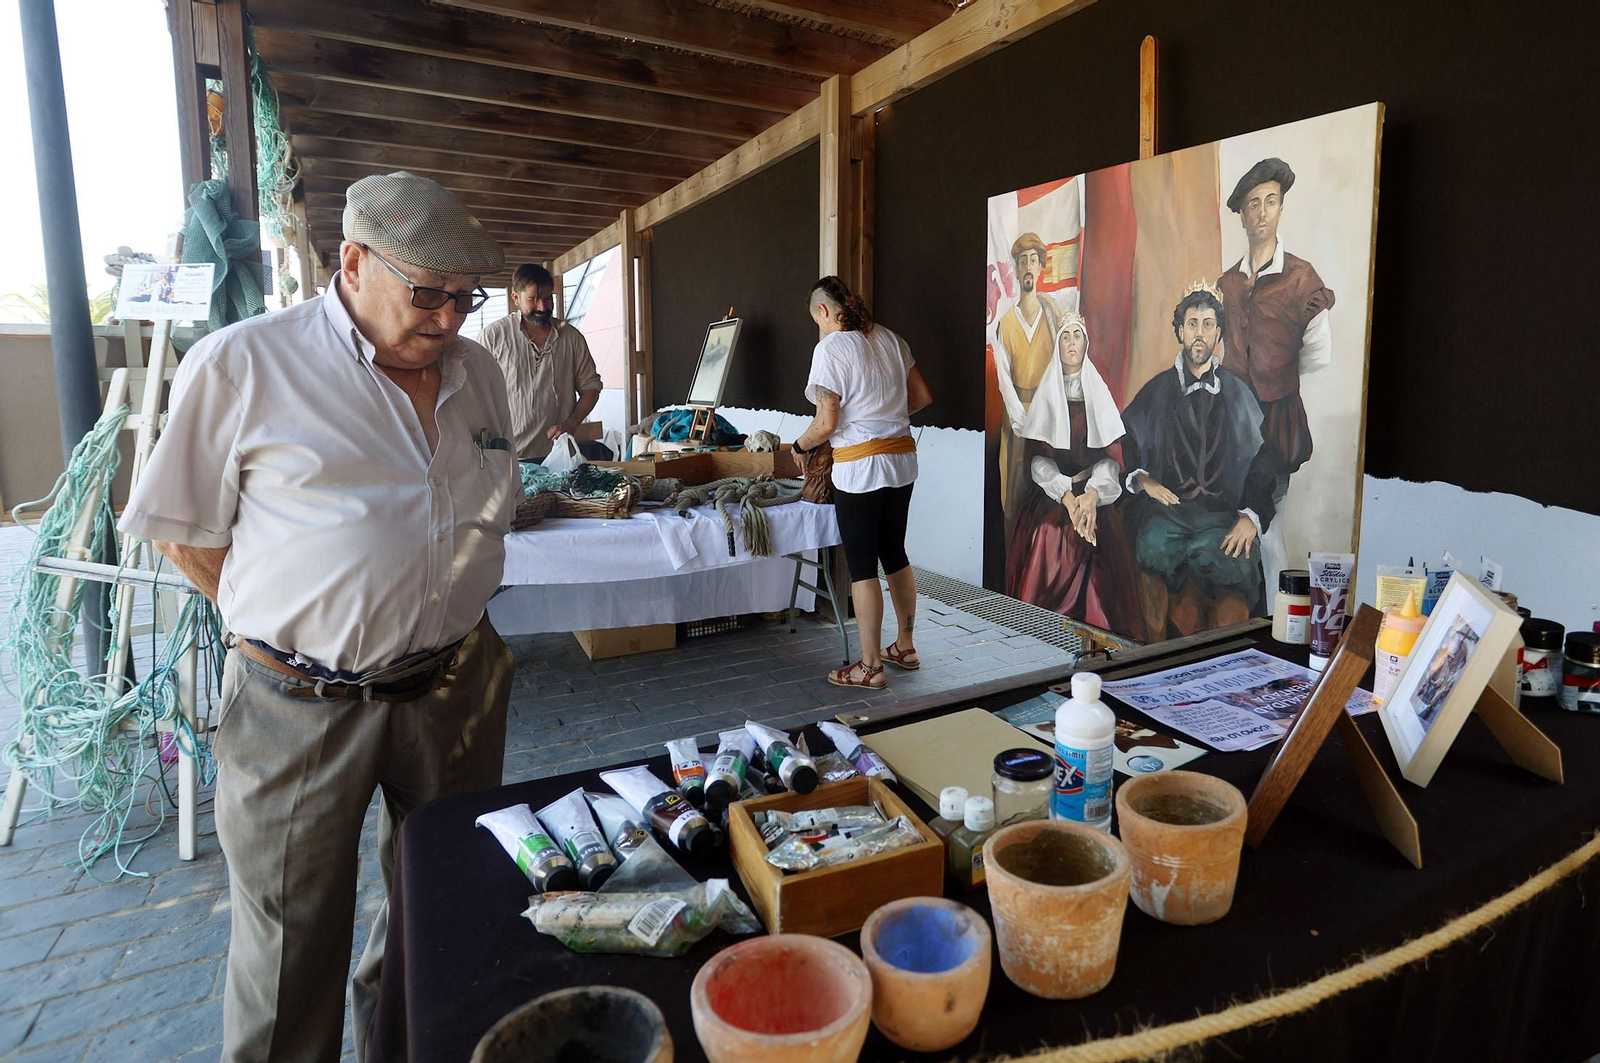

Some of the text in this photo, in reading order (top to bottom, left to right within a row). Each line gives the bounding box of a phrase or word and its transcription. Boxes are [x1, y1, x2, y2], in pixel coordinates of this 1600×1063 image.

[155, 306, 195, 315] MARINEROS
[1319, 570, 1345, 578] Studio
[1214, 672, 1267, 688] VISIÓN
[1193, 683, 1220, 694] DE
[1159, 689, 1199, 702] 1492
